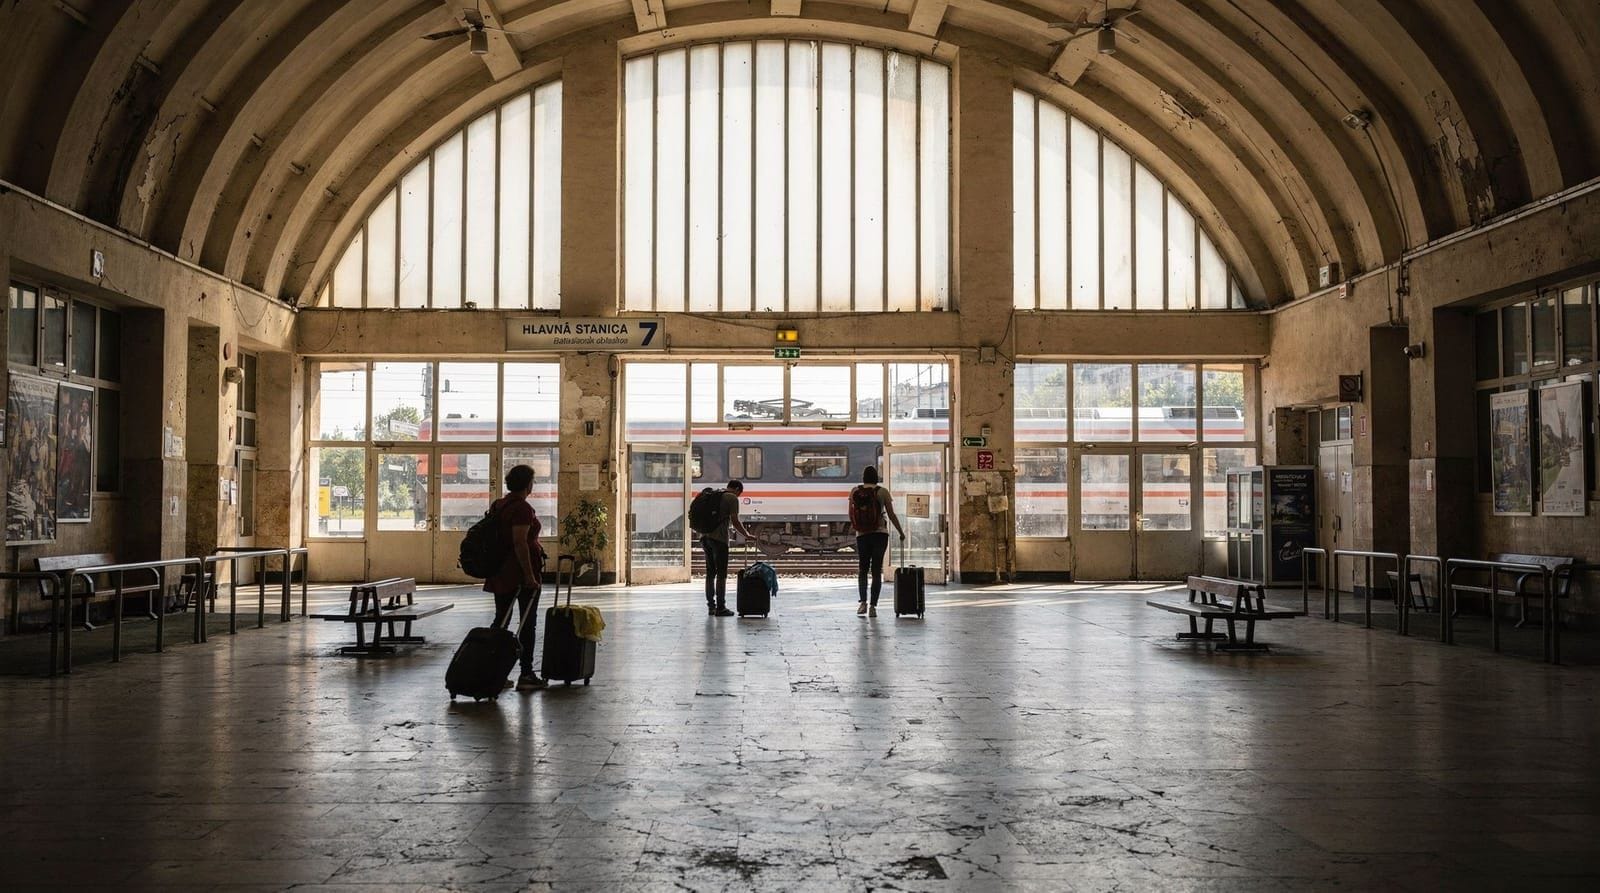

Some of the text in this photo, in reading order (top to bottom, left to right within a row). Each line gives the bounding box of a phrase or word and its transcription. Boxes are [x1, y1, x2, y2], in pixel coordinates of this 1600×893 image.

[523, 322, 629, 335] HLAVNÁ STANICA
[639, 322, 658, 347] 7
